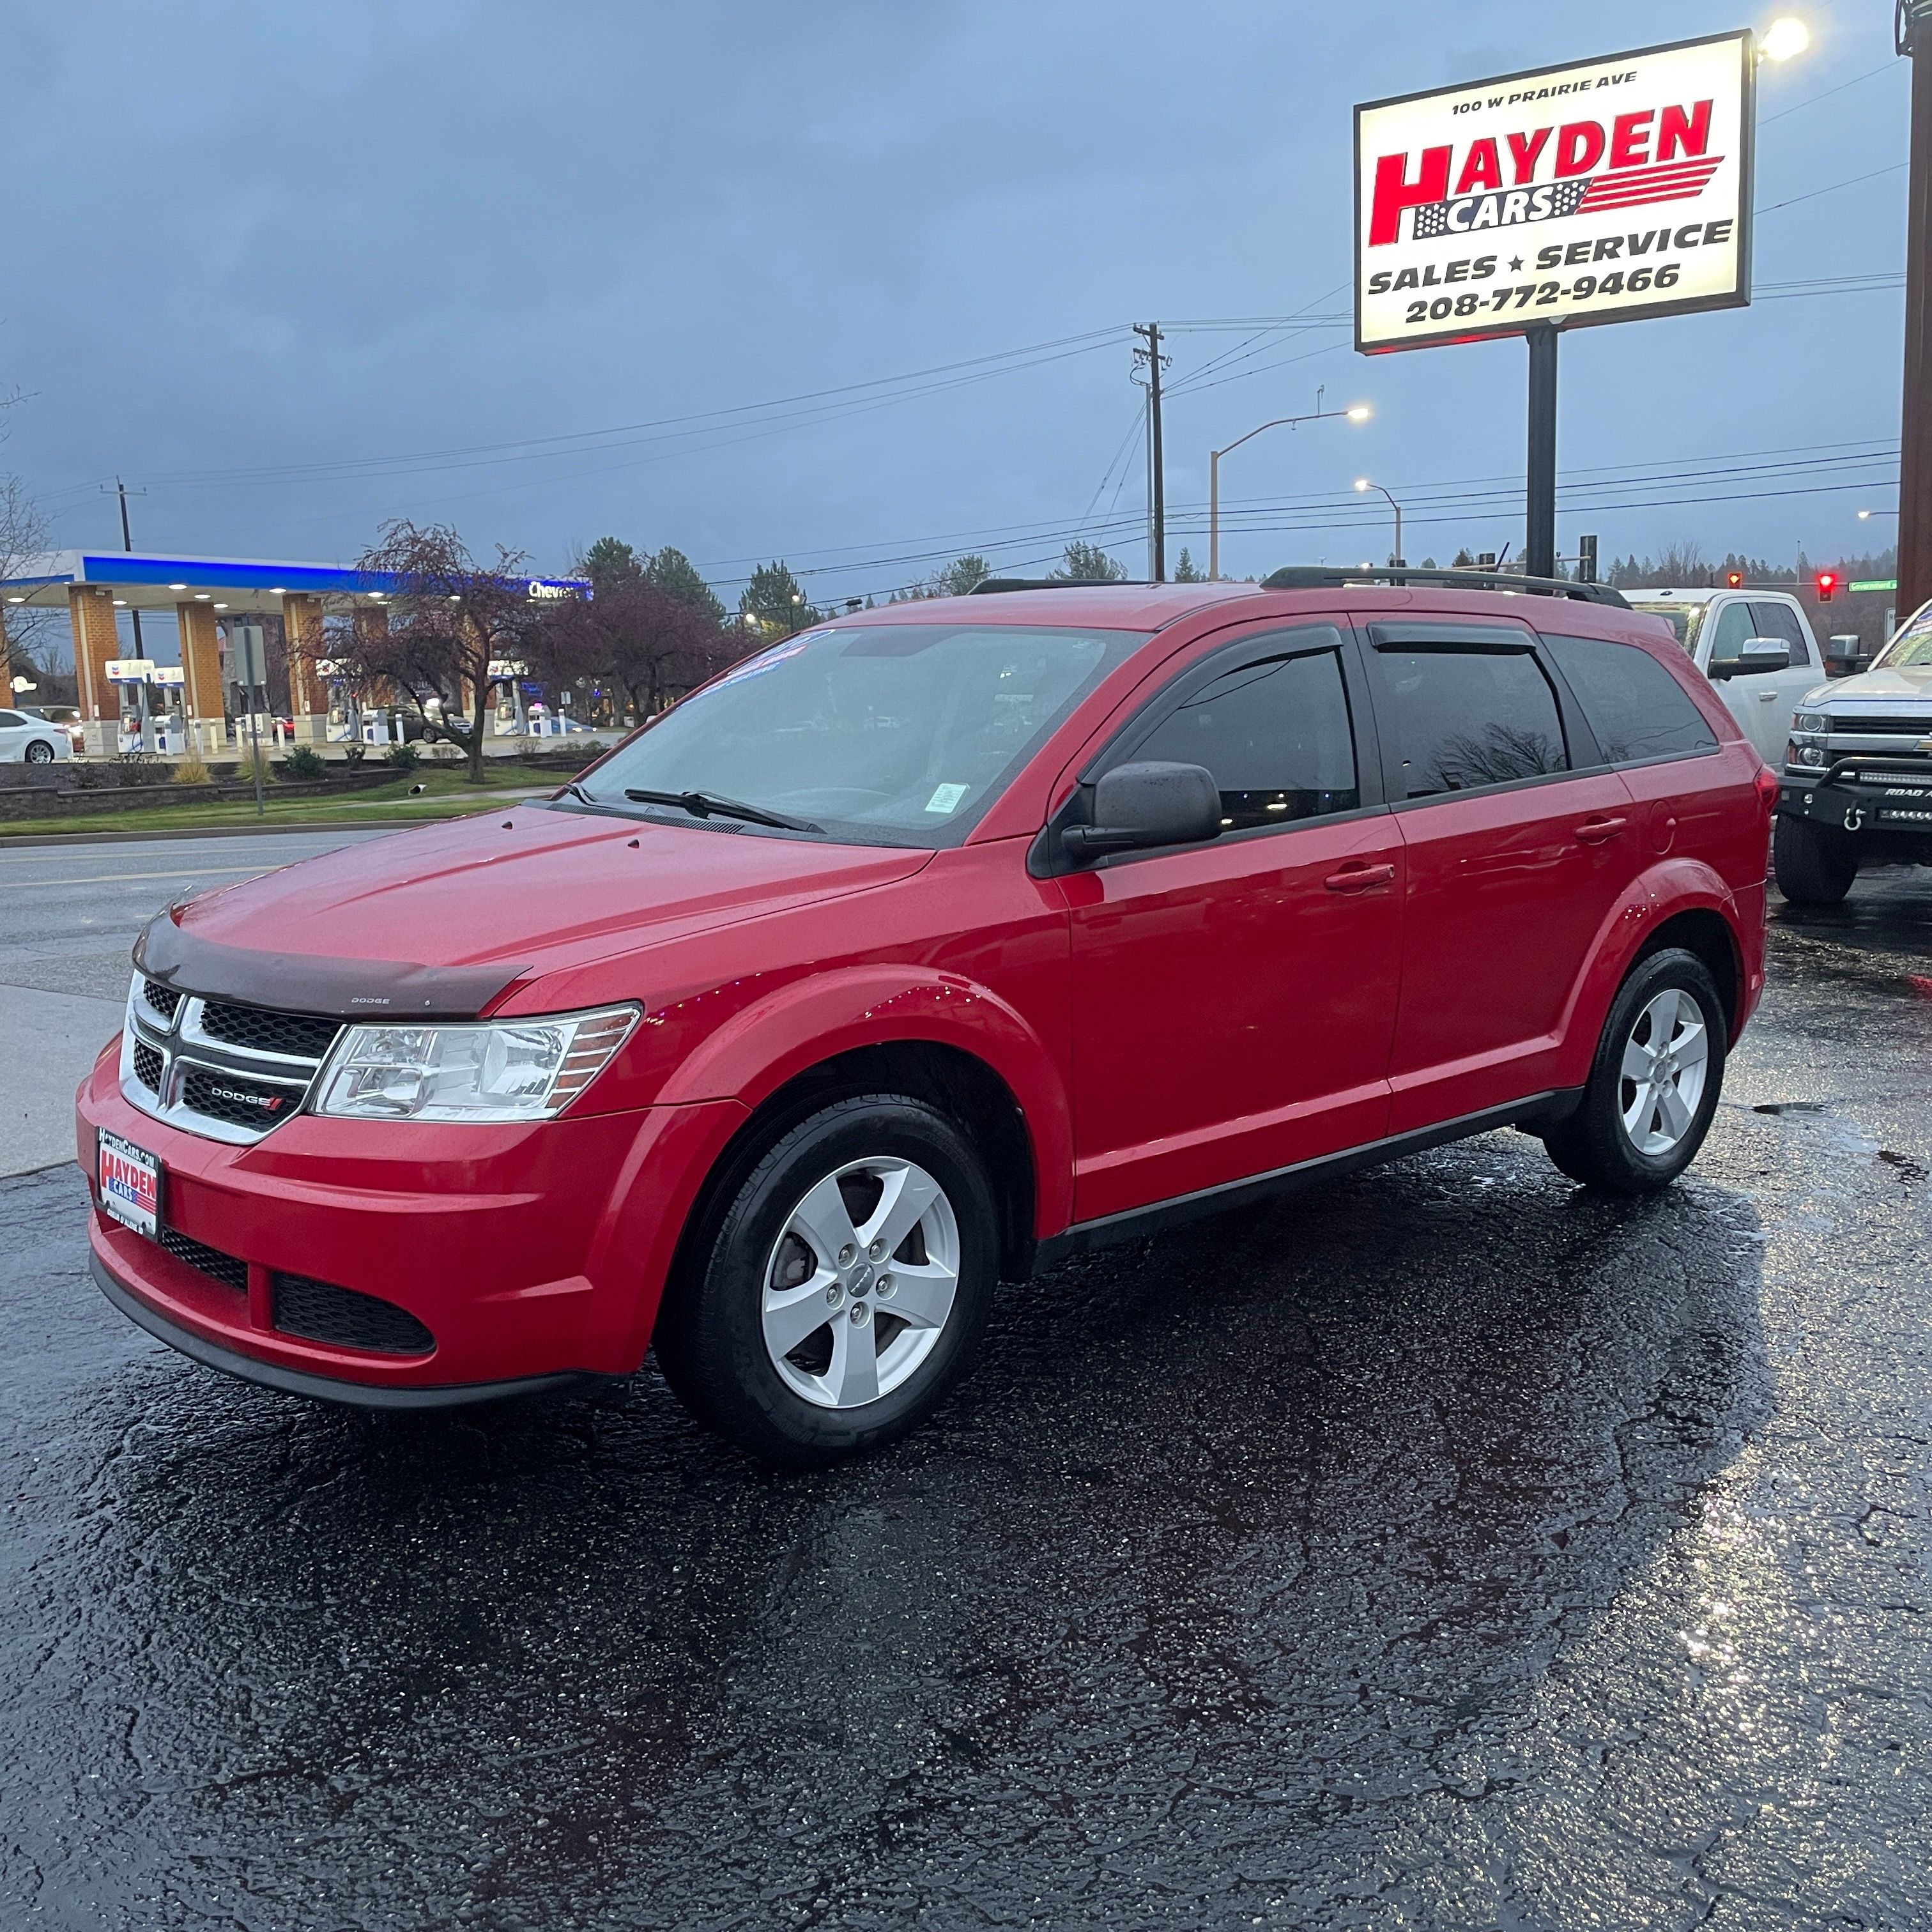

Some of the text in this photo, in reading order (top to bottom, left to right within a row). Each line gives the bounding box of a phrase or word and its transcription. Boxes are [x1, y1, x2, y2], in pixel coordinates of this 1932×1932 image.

[1452, 71, 1637, 115] 100 W PRAIRIE AVE
[1368, 99, 1713, 247] HAYDEN
[1445, 187, 1555, 234] CARS
[1368, 218, 1734, 295] SALES SERVICE
[1406, 263, 1681, 323] 208-772-9466
[528, 581, 579, 599] Chevr
[1885, 788, 1924, 797] ROAD
[211, 1087, 271, 1107] DODGE
[101, 1150, 156, 1199] HAYDEN
[113, 1181, 132, 1202] CARS
